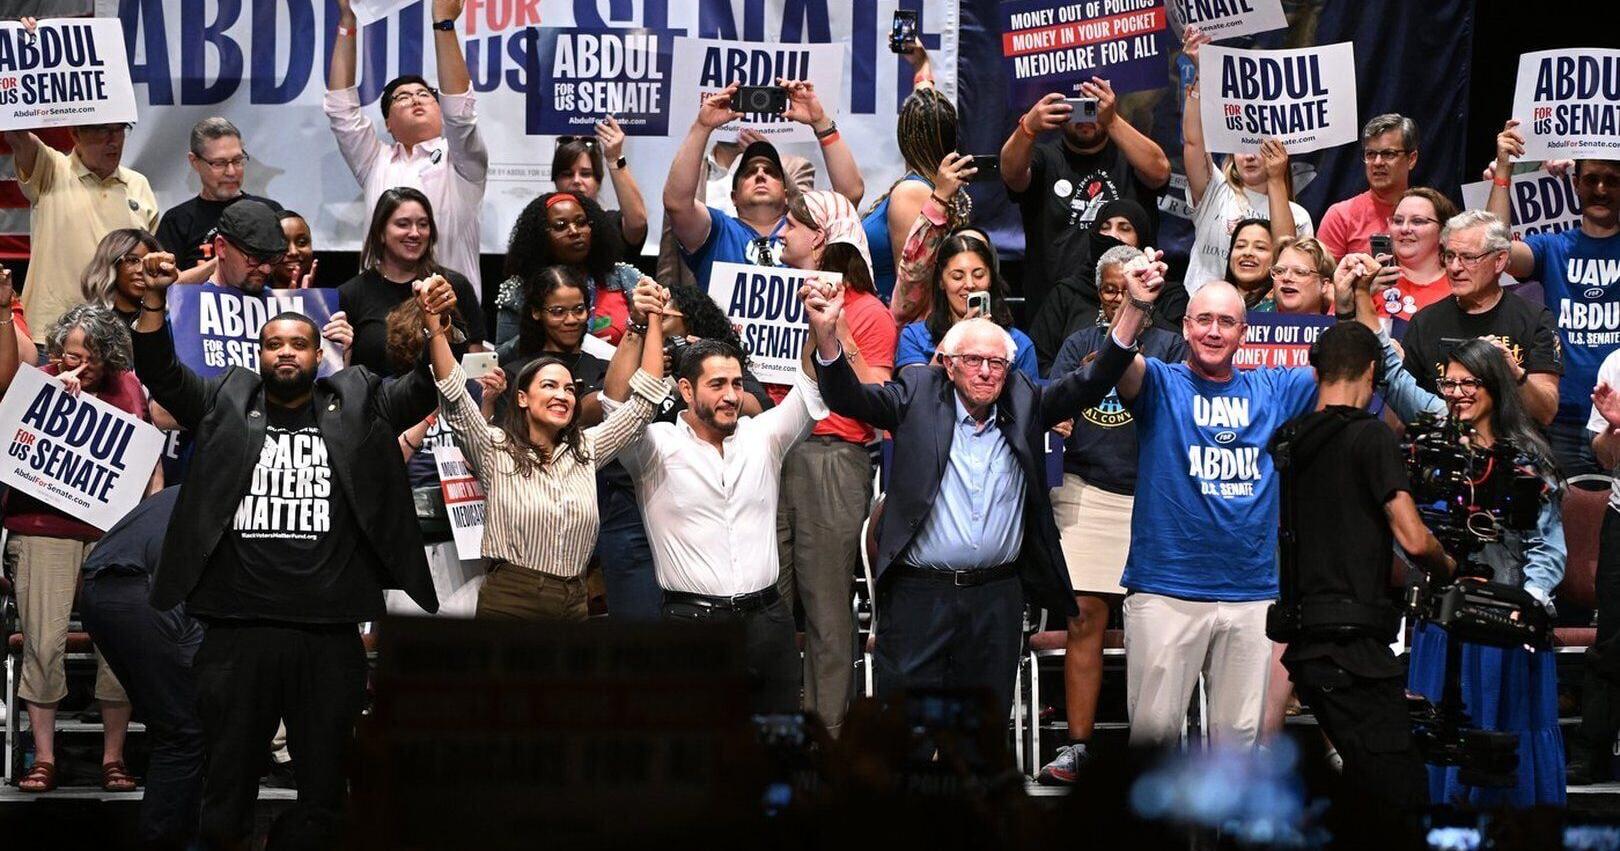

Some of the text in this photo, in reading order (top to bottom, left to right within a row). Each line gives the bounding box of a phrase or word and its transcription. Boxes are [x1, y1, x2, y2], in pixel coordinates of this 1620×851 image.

[1011, 8, 1055, 30] MONEY
[1058, 4, 1082, 23] OUT
[1086, 1, 1100, 18] OF
[1012, 29, 1057, 52] MONEY
[1060, 28, 1075, 45] IN
[1079, 23, 1110, 41] YOUR
[1113, 12, 1156, 35] POCKET
[0, 24, 105, 72] ABDUL
[552, 33, 663, 79] ABDUL
[1014, 34, 1159, 79] MEDICARE FOR ALL
[21, 70, 108, 105] SENATE
[1221, 54, 1329, 101] ABDUL
[1533, 55, 1620, 102] ABDU
[13, 106, 96, 118] AbdulForSenate.com
[554, 81, 661, 114] FOR US SENATE
[1224, 98, 1330, 135] FOR US SENATE
[1534, 104, 1620, 136] FOR US SENA
[1567, 258, 1620, 287] UAW
[728, 272, 809, 324] ABDU
[1558, 298, 1620, 331] ABDU
[1246, 325, 1320, 343] NEY OUT OF
[1567, 331, 1585, 344] U.S.
[203, 338, 227, 368] FOR US
[1273, 348, 1287, 365] IN
[1292, 348, 1309, 366] YO
[21, 383, 136, 471] ABDUL
[1193, 394, 1250, 429] UAW
[8, 442, 31, 462] US
[14, 428, 36, 446] FOR
[274, 433, 329, 469] ACK
[29, 438, 120, 504] SENATE
[250, 463, 332, 498] OTERS
[1189, 445, 1262, 481] ABDUL
[13, 467, 91, 509] AbdulForSenate.com
[1220, 482, 1254, 496] SENATE
[233, 495, 331, 532] MATTER
